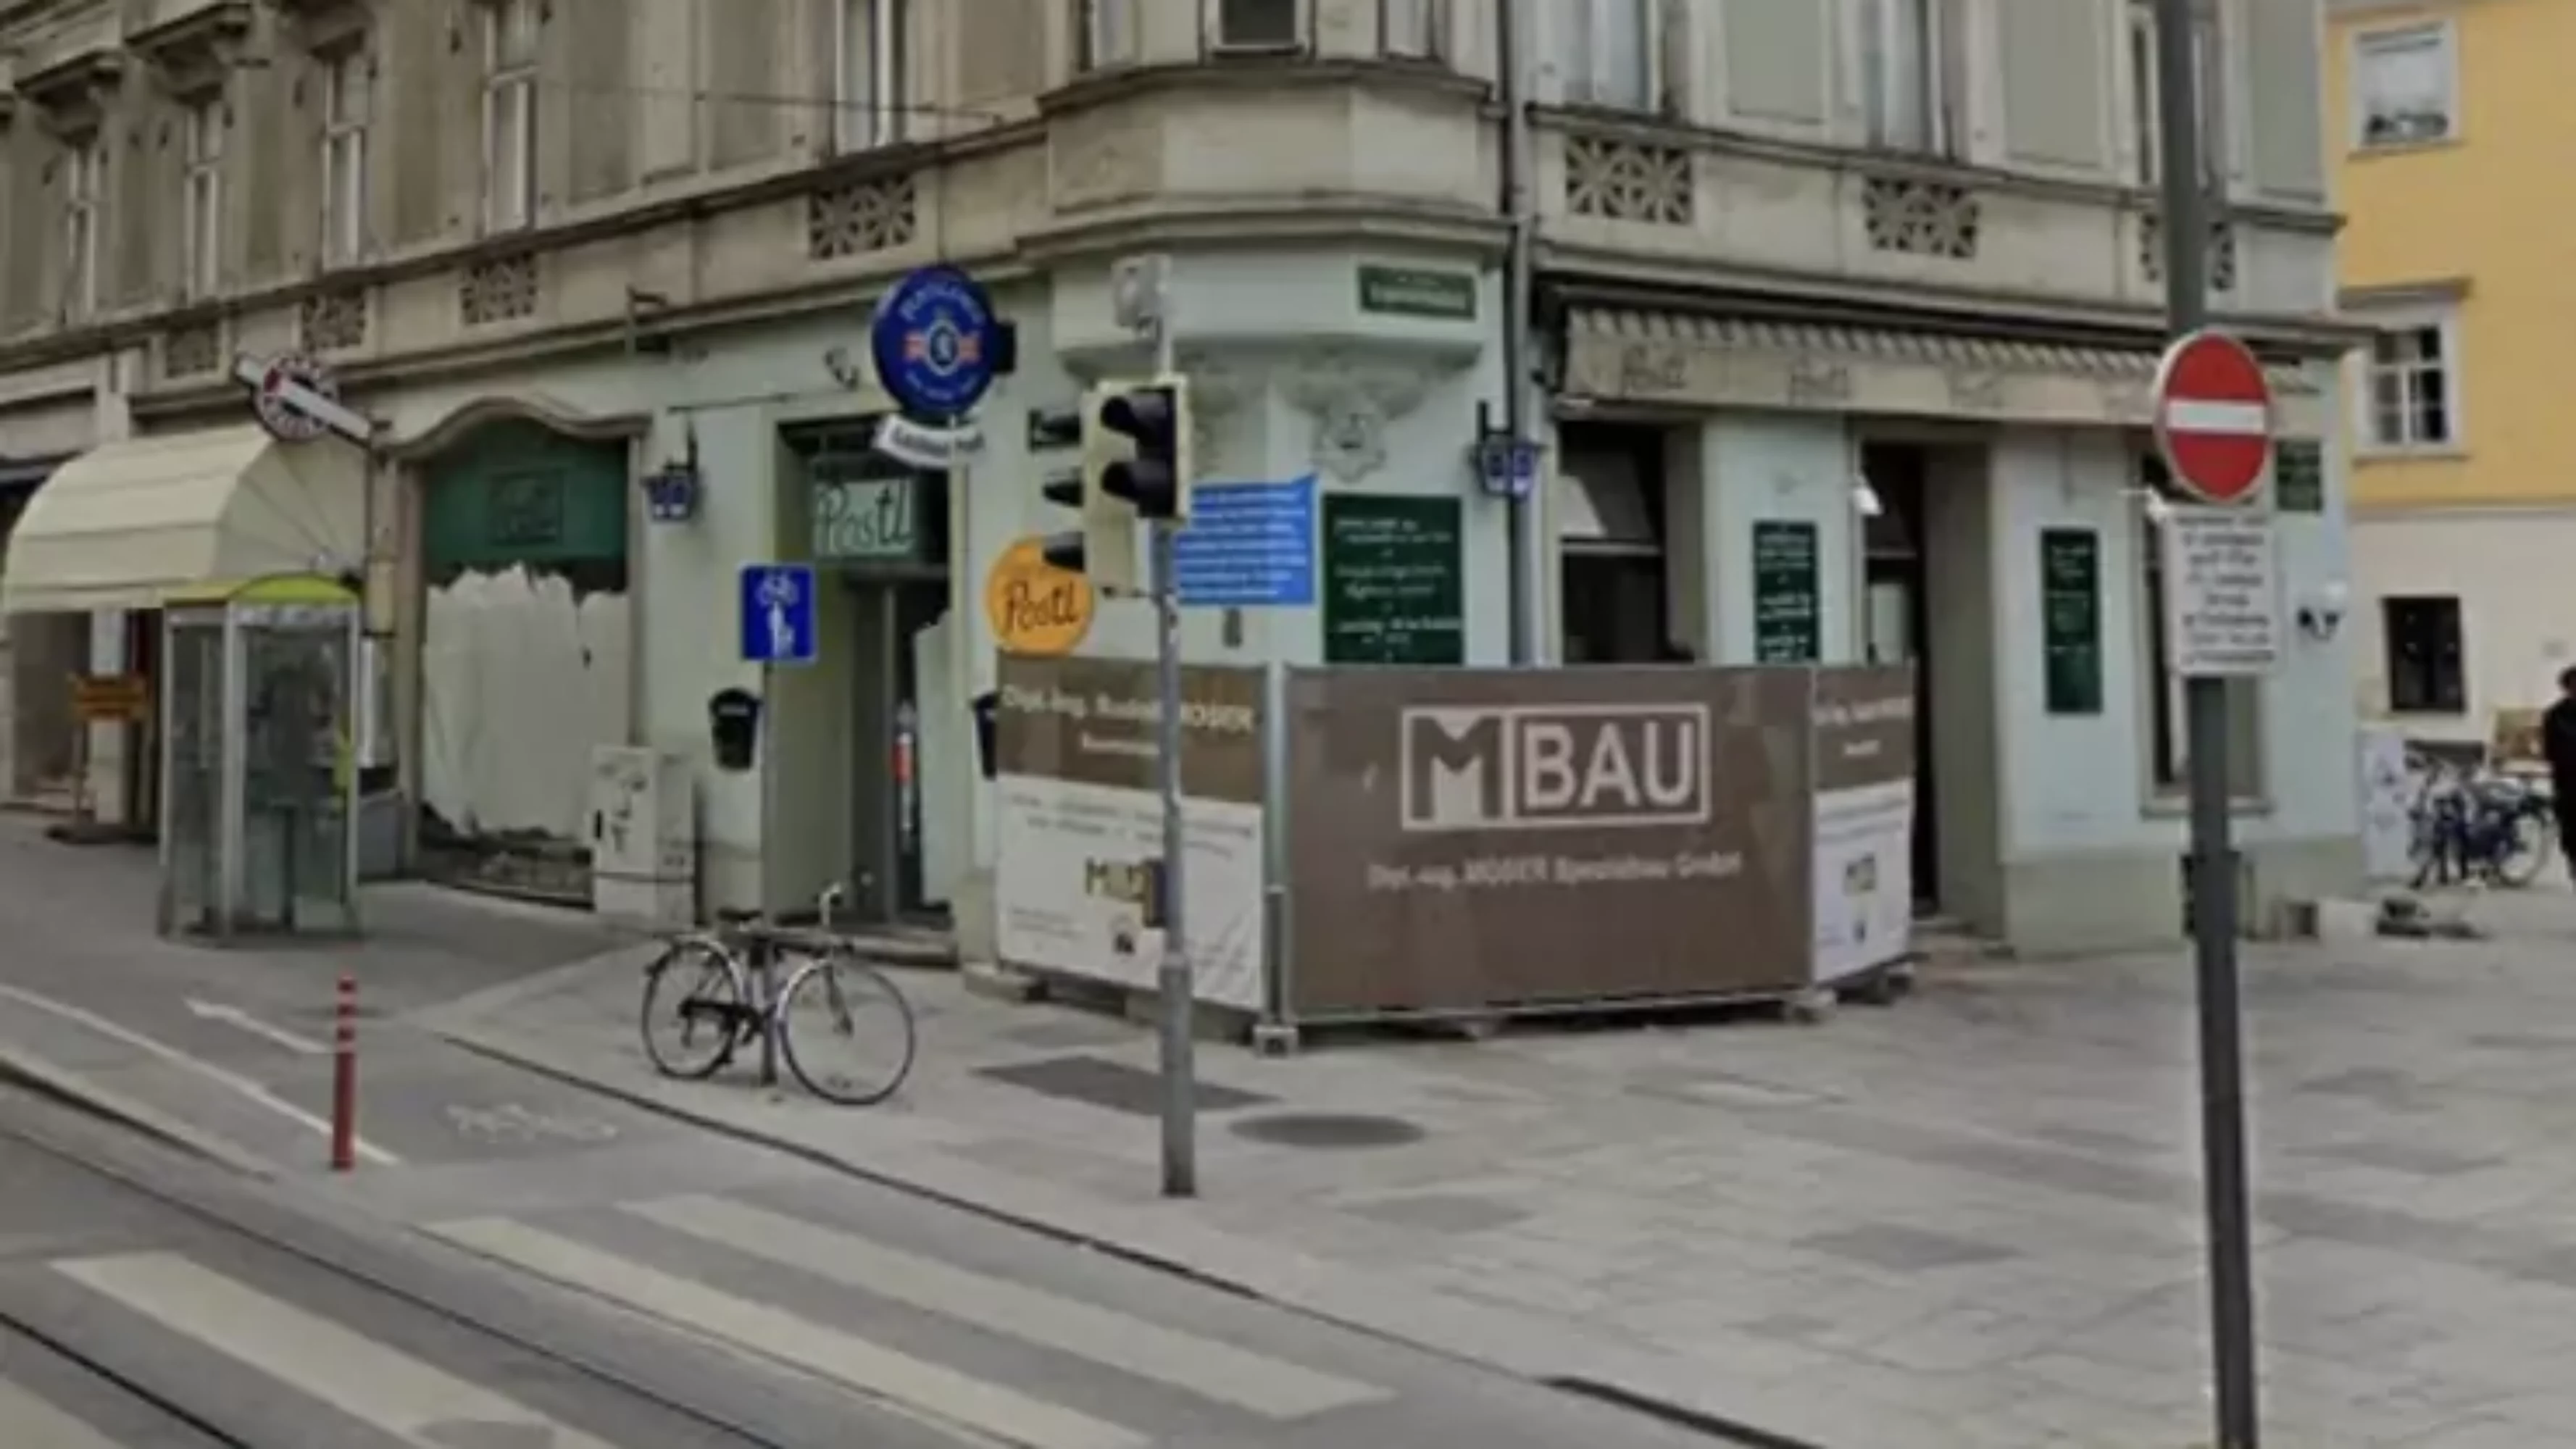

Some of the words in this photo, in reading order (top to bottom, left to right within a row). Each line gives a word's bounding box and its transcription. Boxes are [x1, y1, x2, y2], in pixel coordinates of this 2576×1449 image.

[817, 478, 916, 554] Postl
[1004, 580, 1081, 632] Postl
[1522, 718, 1695, 809] BAU
